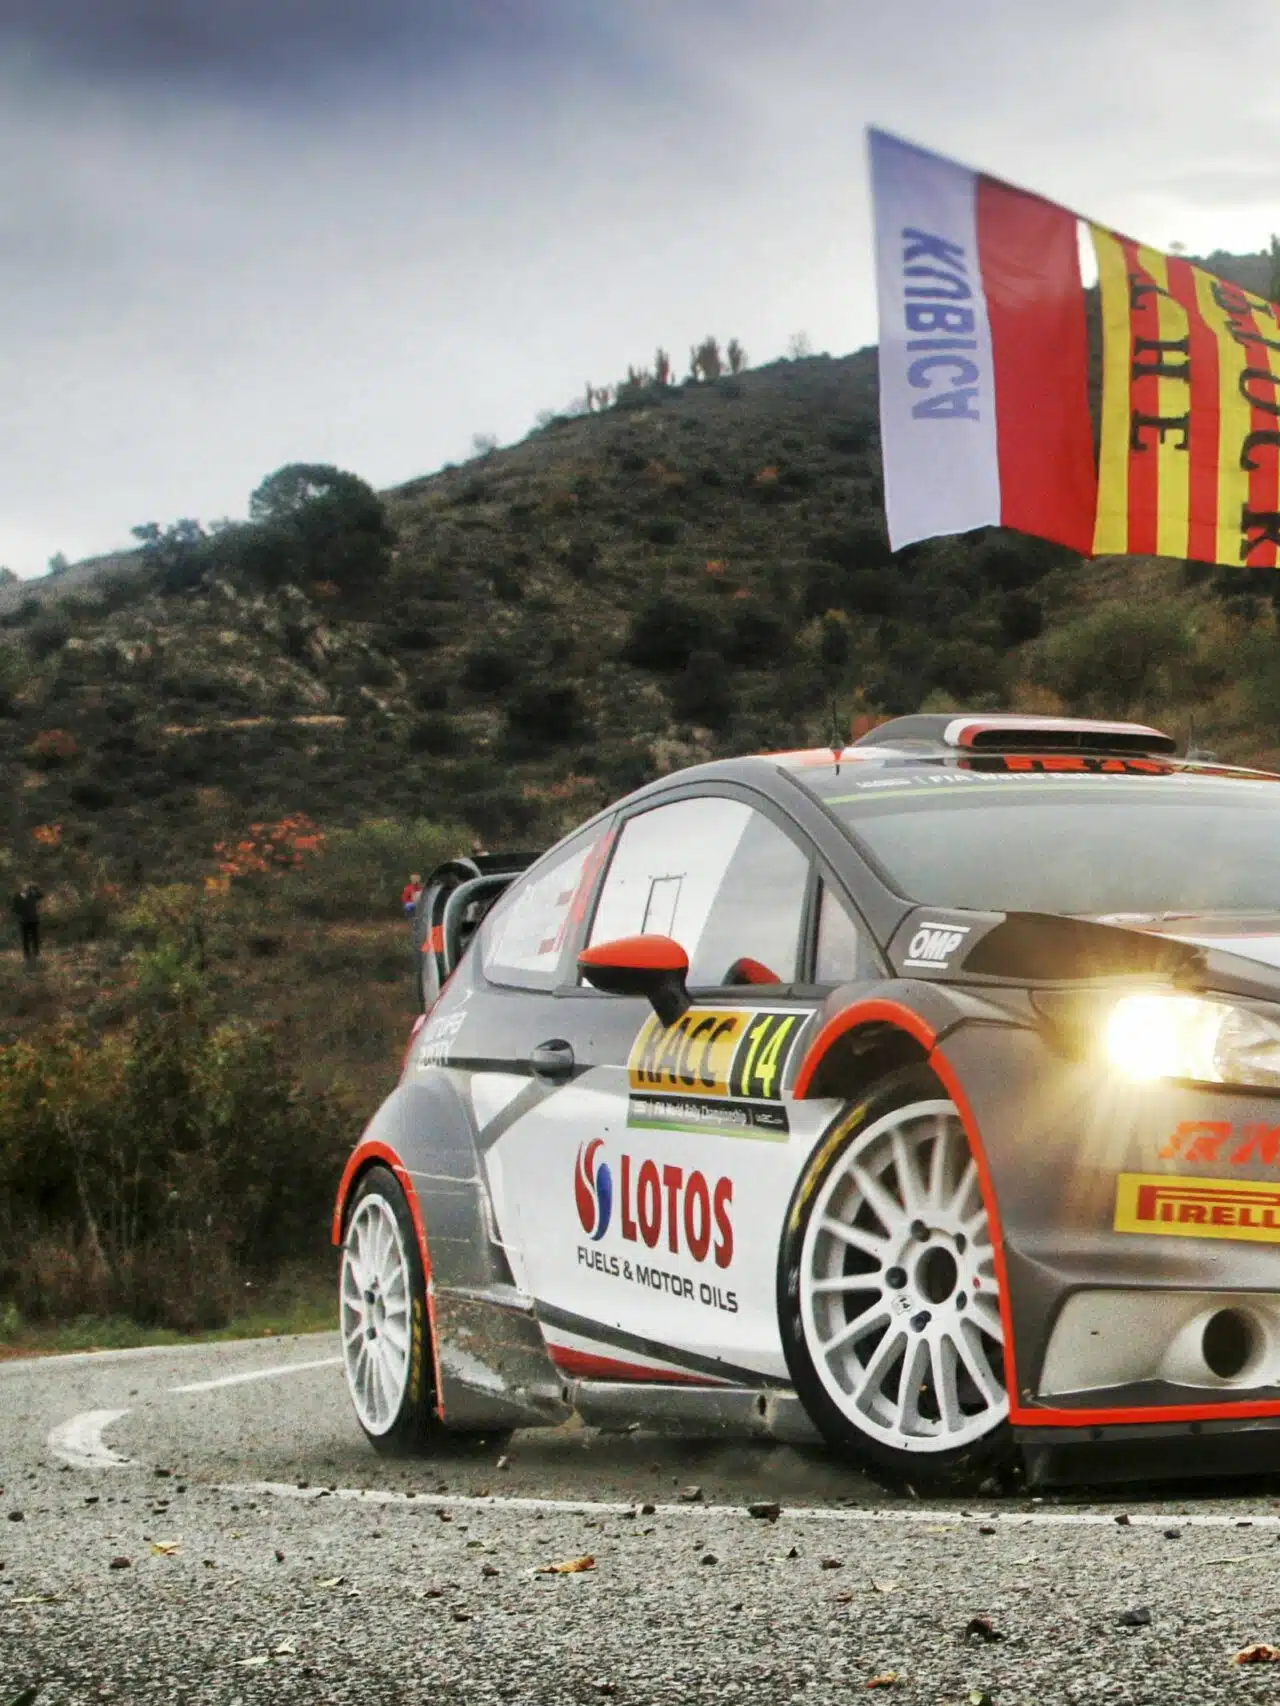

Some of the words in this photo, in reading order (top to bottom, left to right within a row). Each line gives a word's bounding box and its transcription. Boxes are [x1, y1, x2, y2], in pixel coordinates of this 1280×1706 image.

[909, 929, 963, 960] OMP
[637, 1016, 739, 1088] RACC
[740, 1015, 796, 1098] 14
[620, 1154, 734, 1269] LOTOS
[577, 1246, 620, 1277] FUELS
[623, 1260, 634, 1282] &
[636, 1263, 695, 1300] MOTOR
[699, 1282, 739, 1313] OILS
